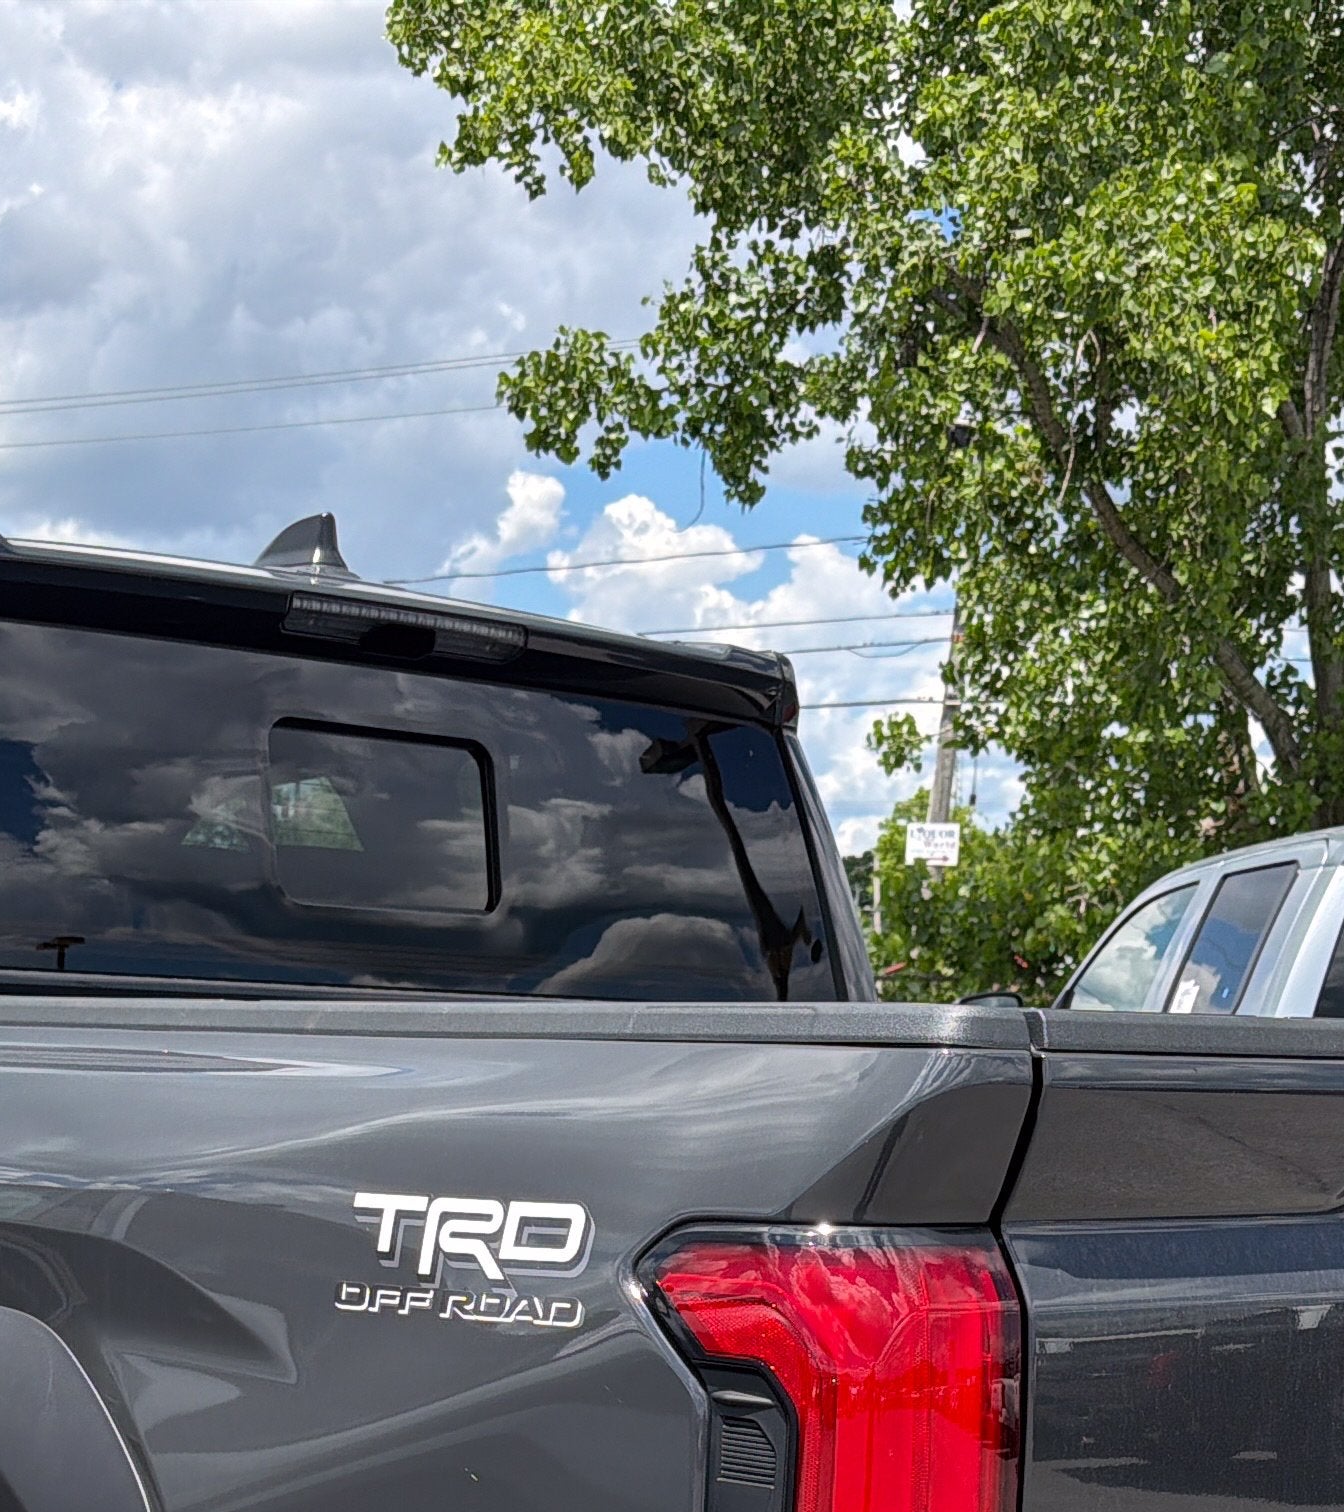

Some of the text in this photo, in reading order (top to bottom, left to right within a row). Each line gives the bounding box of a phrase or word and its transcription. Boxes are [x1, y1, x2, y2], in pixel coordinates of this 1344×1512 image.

[353, 1192, 596, 1296] TRD
[334, 1281, 585, 1328] OFF ROAD
